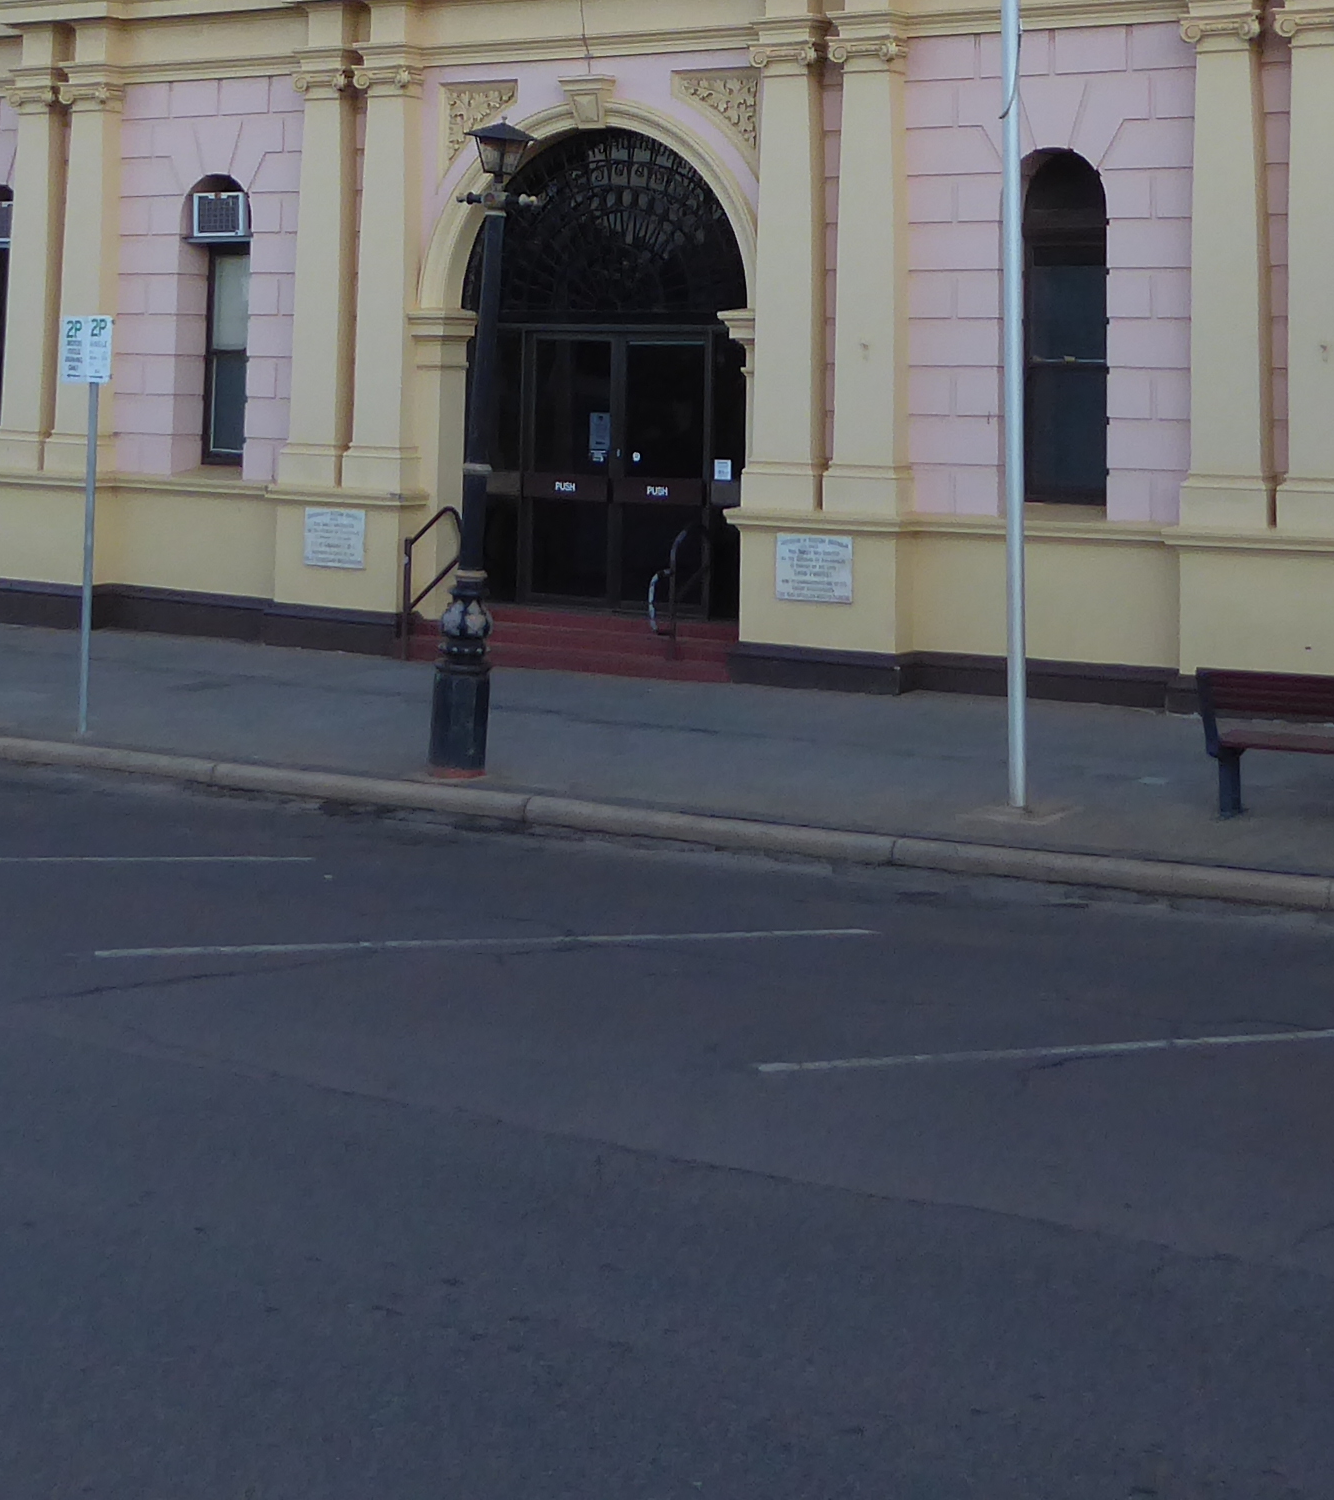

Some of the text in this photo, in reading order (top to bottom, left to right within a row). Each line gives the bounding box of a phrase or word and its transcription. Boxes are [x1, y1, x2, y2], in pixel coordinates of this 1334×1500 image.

[66, 320, 83, 339] 2P
[90, 318, 108, 337] 2P
[555, 481, 576, 492] PUSH
[646, 485, 668, 496] PUSH
